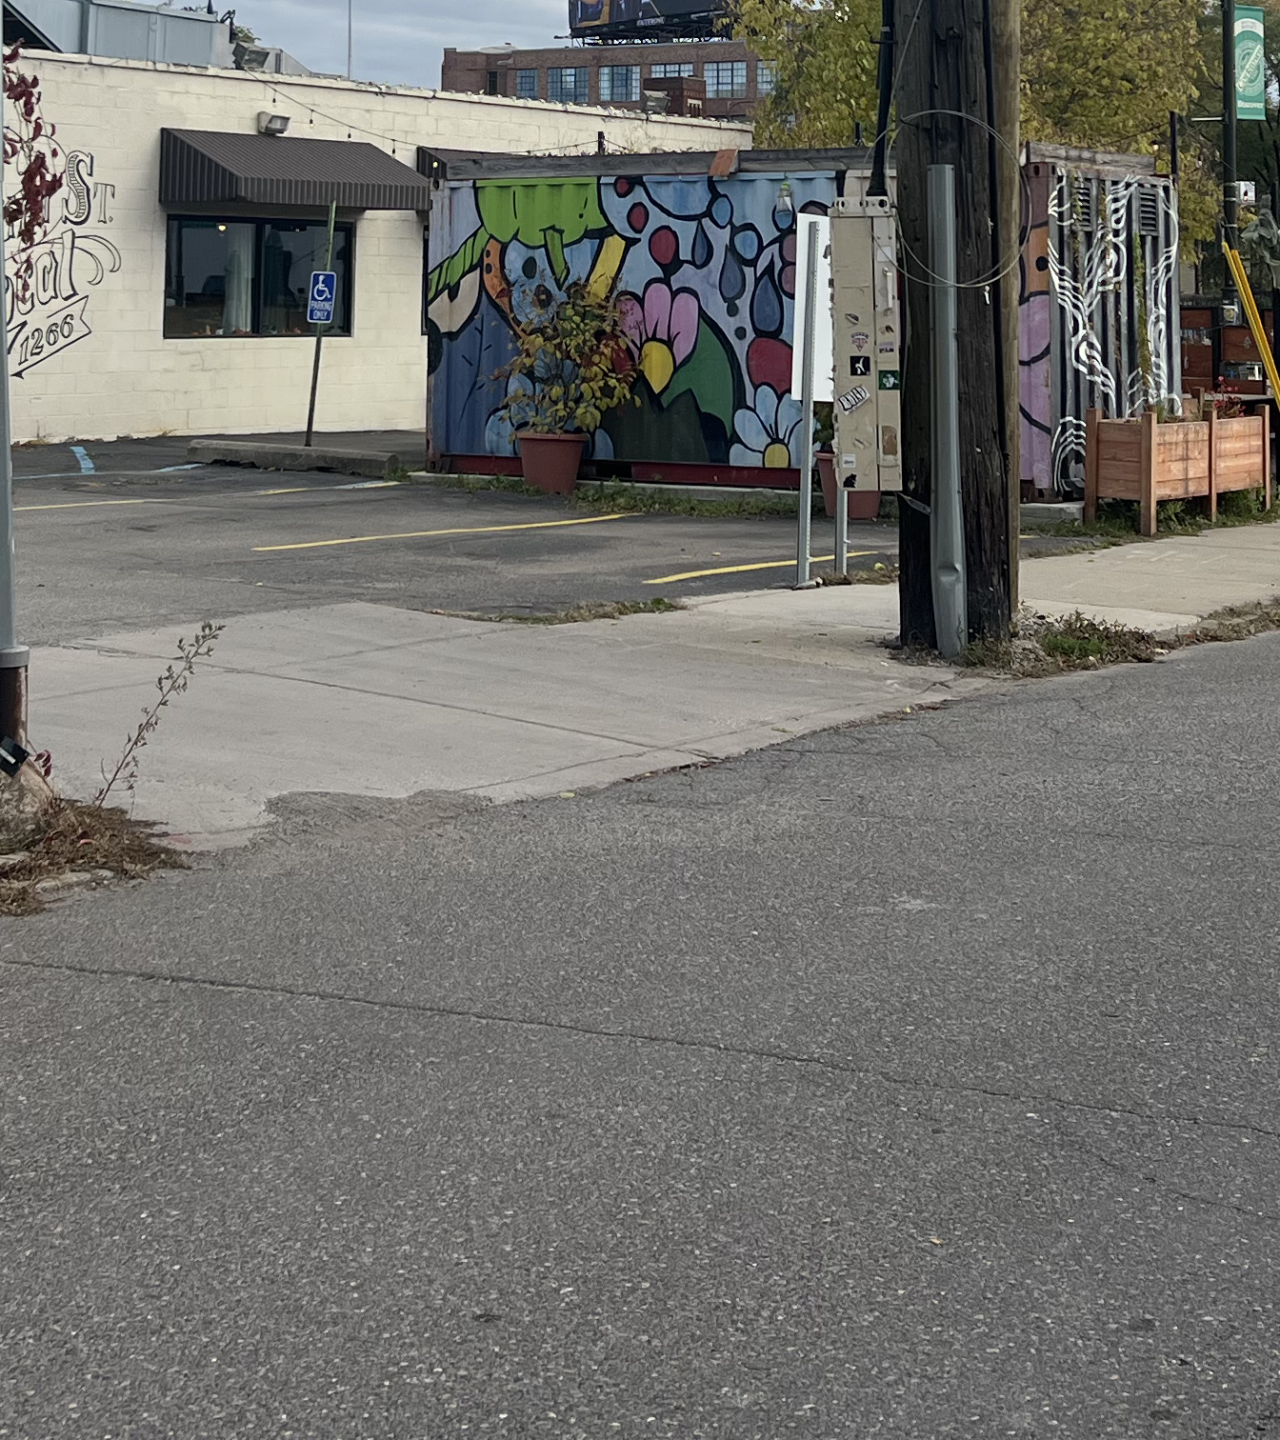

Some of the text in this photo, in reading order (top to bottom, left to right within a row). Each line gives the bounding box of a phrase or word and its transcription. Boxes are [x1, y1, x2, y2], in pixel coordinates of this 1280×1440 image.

[310, 300, 332, 310] PARKING
[313, 310, 328, 320] ONLY
[18, 313, 75, 366] 1266
